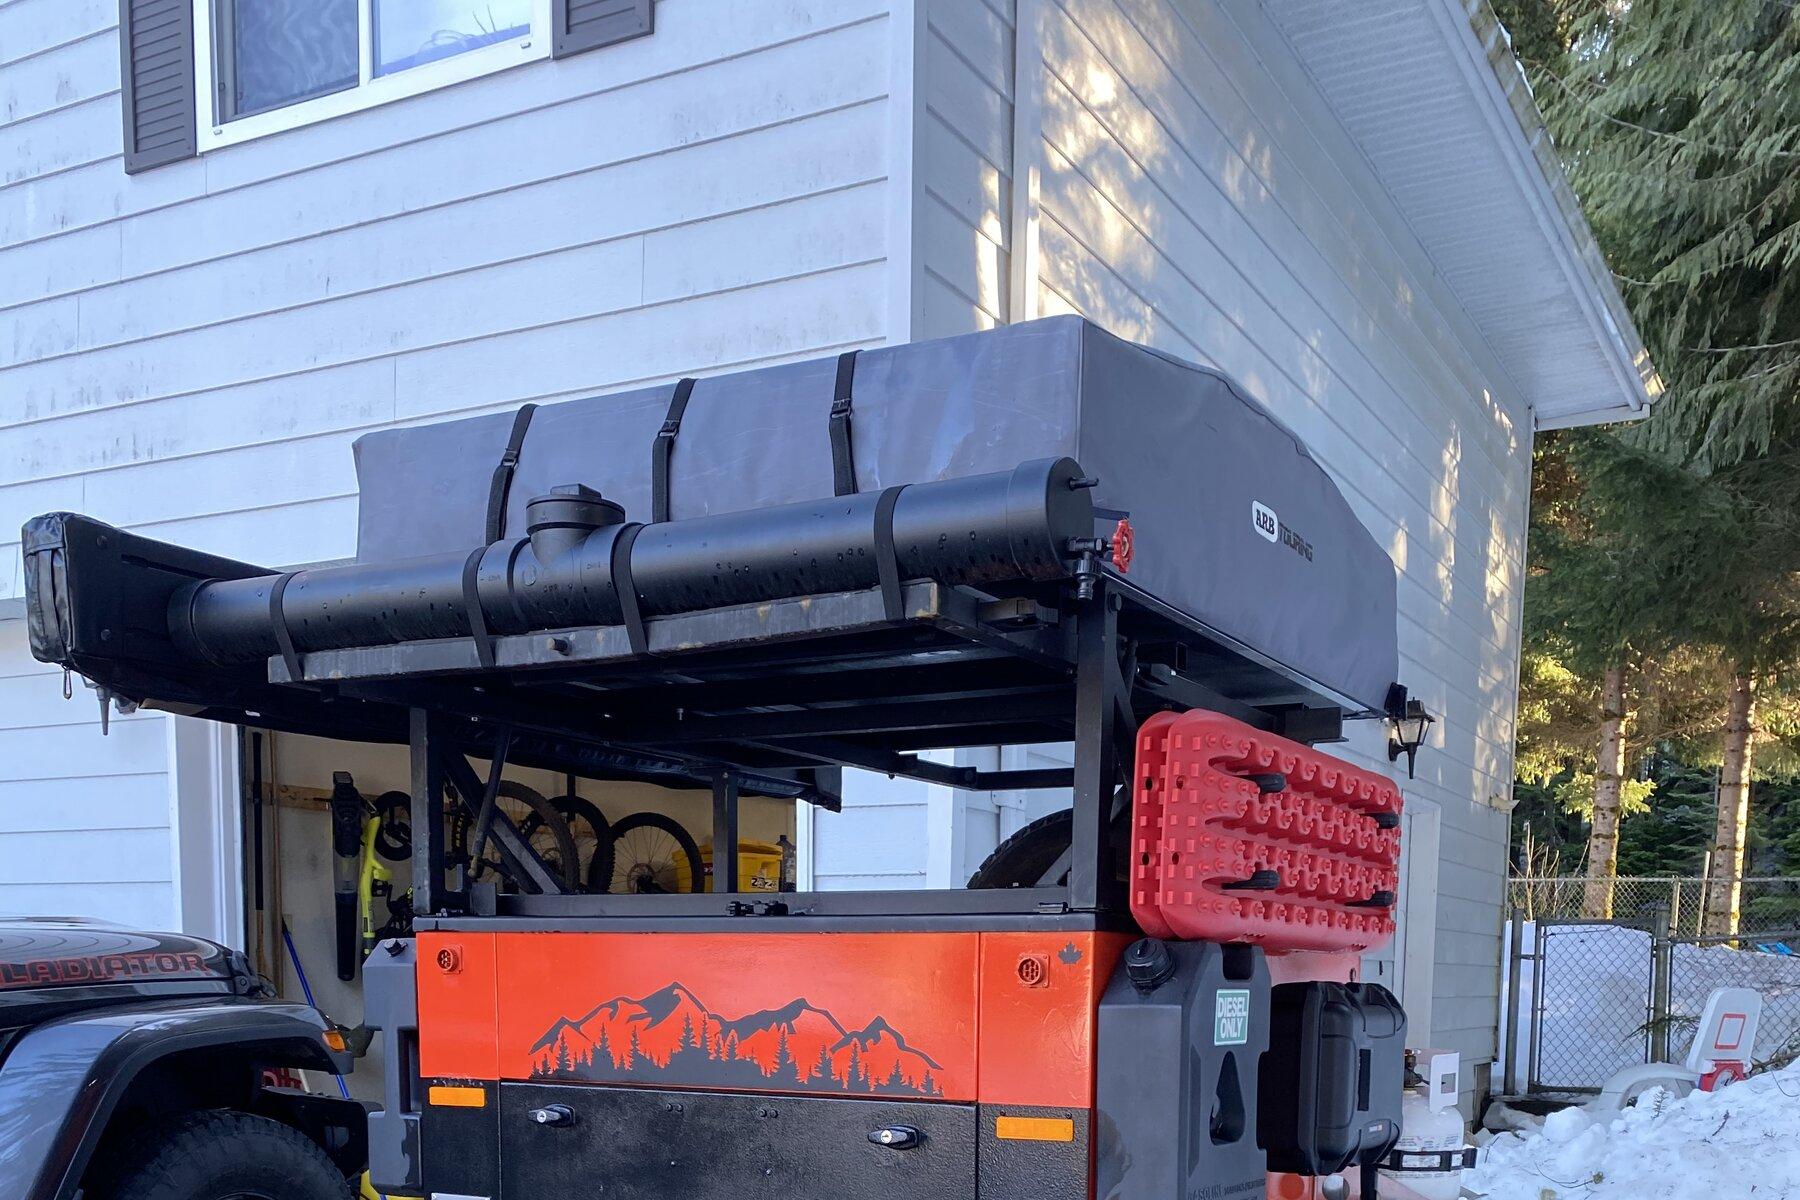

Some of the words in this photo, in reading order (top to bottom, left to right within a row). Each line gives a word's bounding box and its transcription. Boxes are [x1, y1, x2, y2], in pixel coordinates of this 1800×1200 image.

[1255, 508, 1275, 535] ARB
[0, 952, 212, 987] LADIATOR
[1217, 997, 1248, 1018] DIESEL
[1220, 1017, 1244, 1039] ONLY
